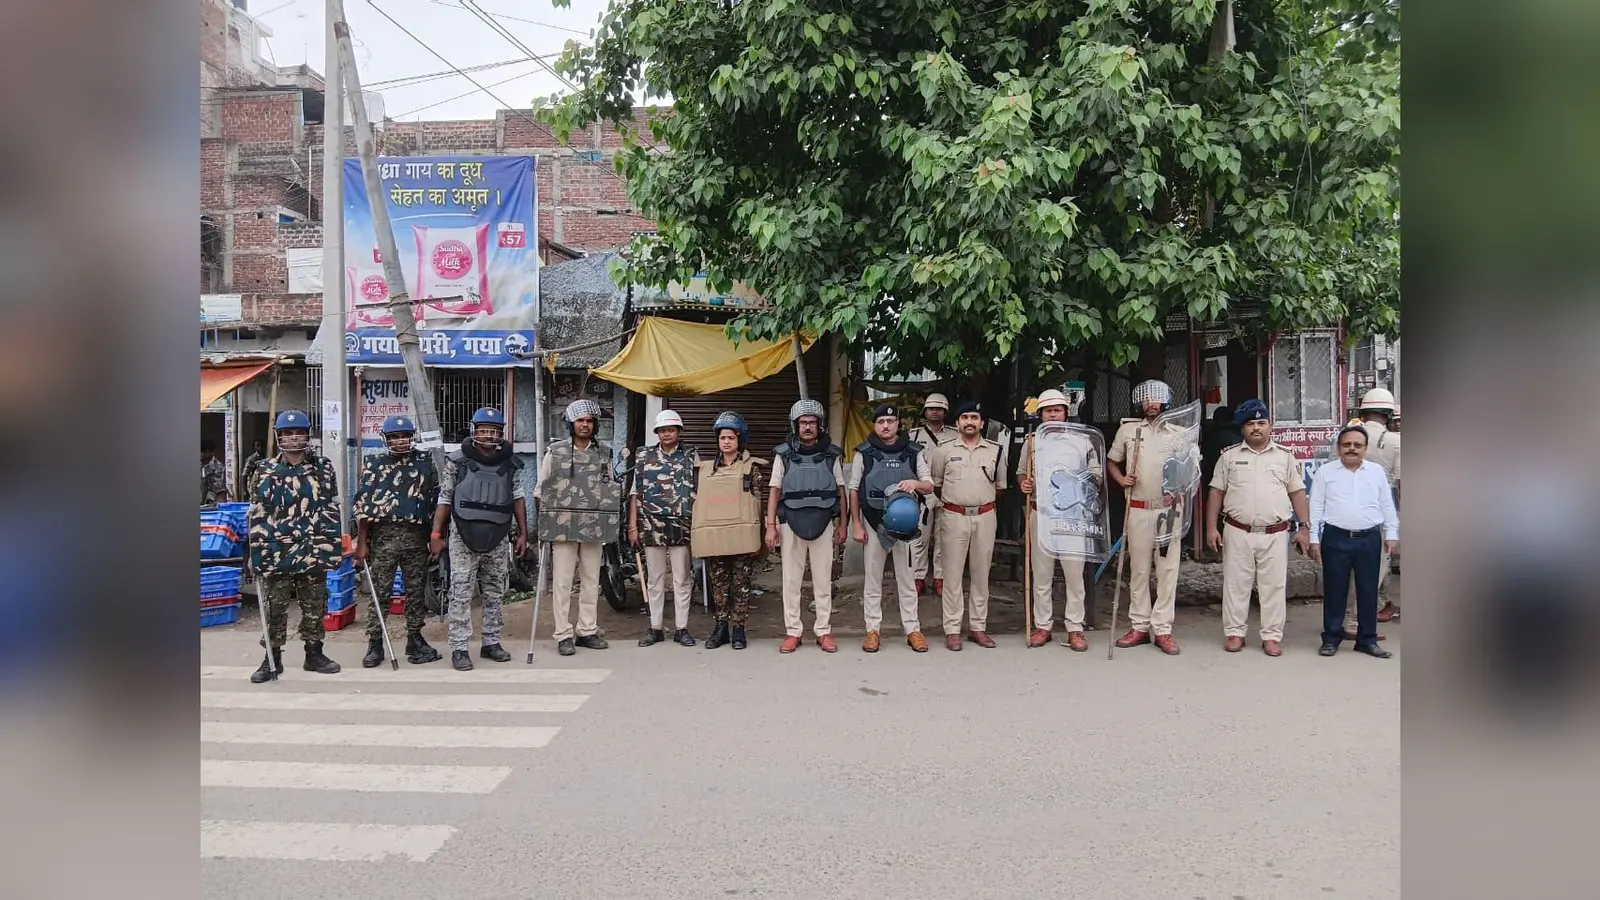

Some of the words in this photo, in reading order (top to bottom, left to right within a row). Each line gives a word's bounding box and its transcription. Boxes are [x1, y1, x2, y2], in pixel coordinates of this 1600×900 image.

[405, 162, 433, 179] गाय
[437, 162, 456, 179] का
[390, 183, 424, 206] सेहत
[428, 188, 447, 205] का
[362, 336, 399, 354] गया
[462, 337, 502, 355] गया
